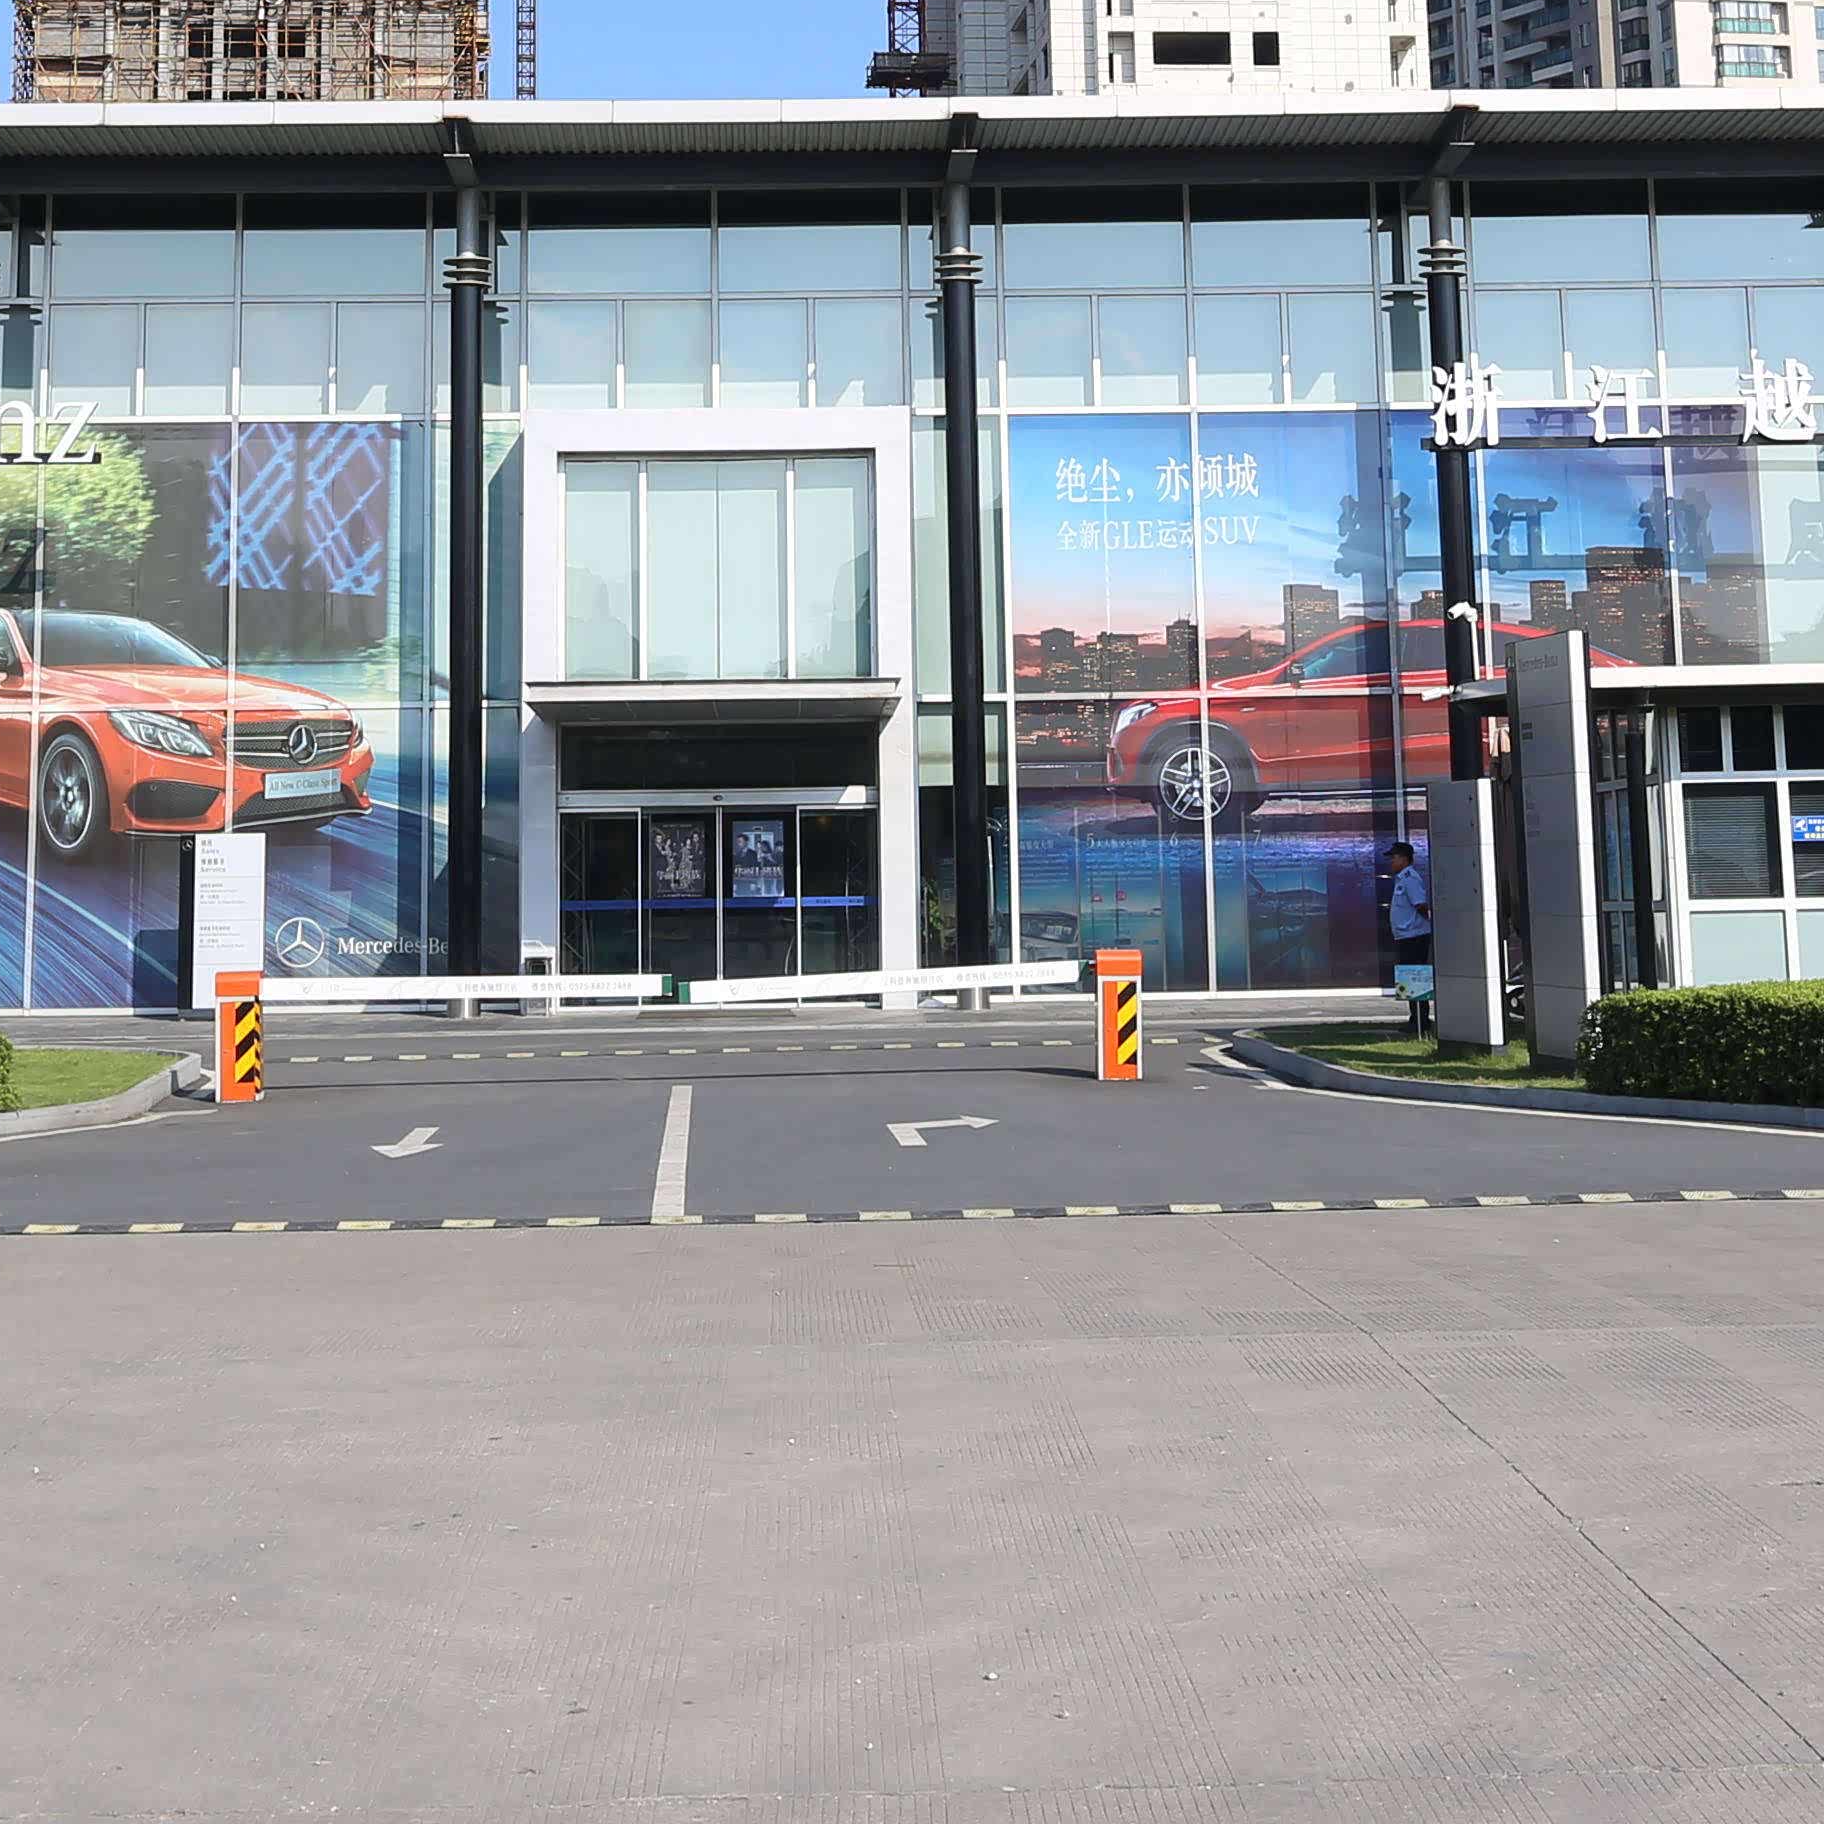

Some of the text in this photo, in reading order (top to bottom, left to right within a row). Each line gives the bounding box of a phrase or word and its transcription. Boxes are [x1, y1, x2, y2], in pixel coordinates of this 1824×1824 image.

[1056, 515, 1261, 552] 全新GLE运动SUV
[337, 936, 448, 956] Mercedes-Be
